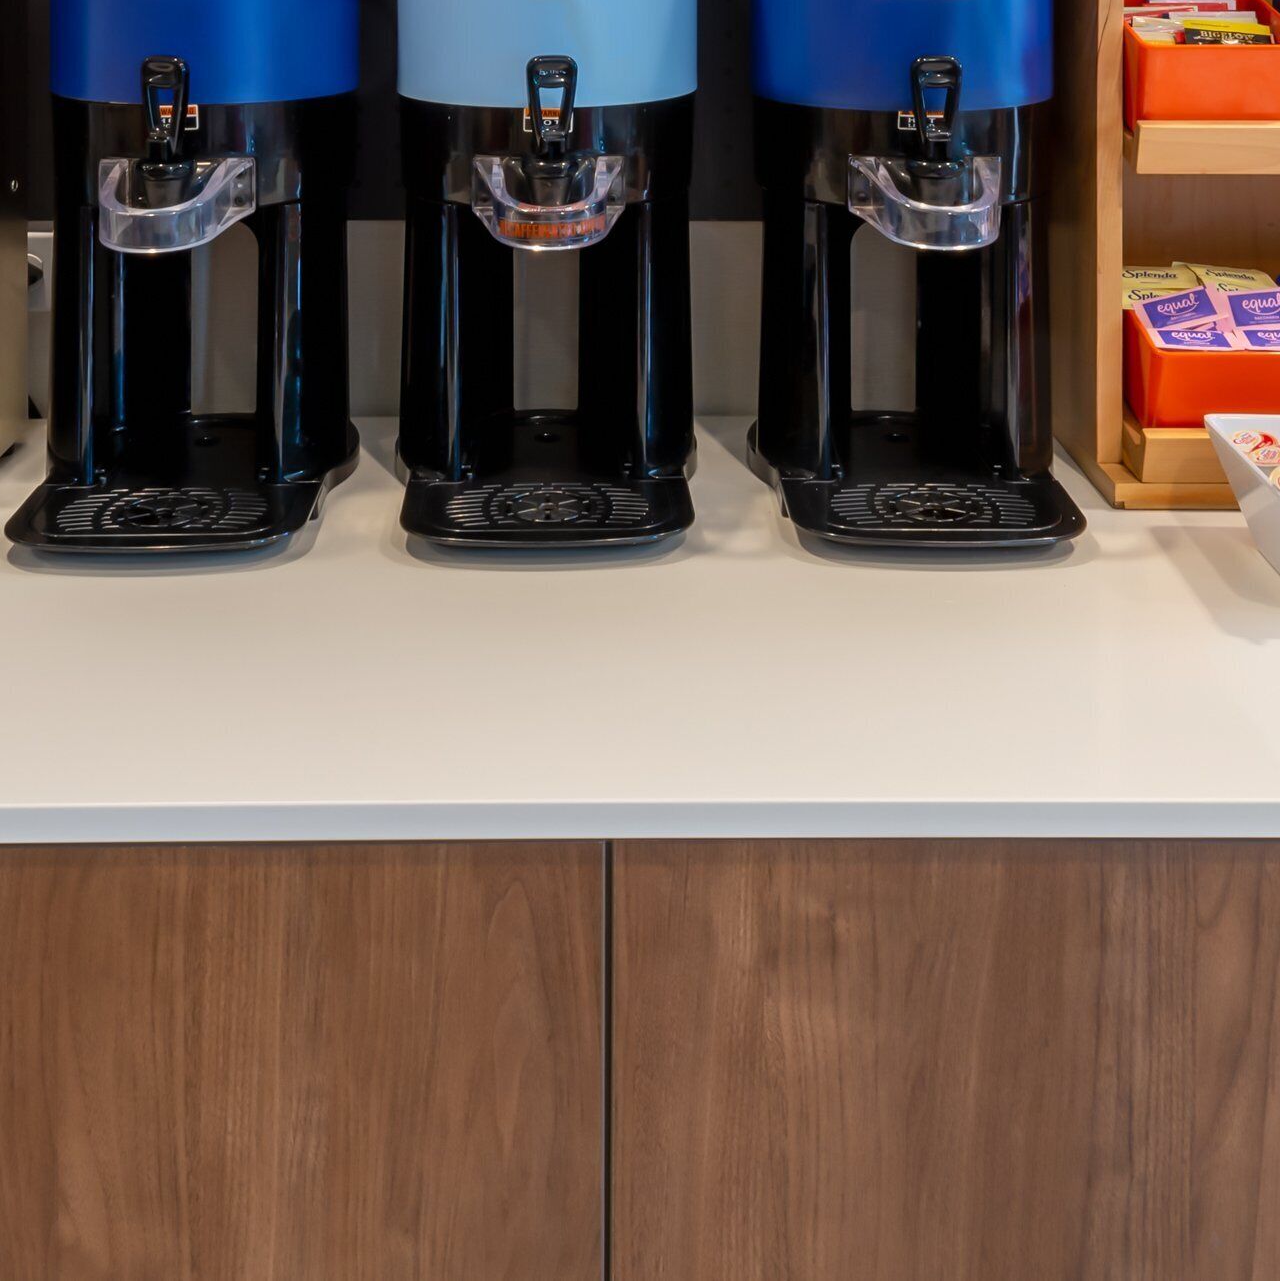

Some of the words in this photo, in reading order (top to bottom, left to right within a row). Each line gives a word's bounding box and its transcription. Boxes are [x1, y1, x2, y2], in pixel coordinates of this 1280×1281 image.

[1122, 269, 1178, 281] Splenda
[1128, 289, 1162, 302] Sple
[1157, 293, 1200, 316] equal
[1171, 330, 1215, 340] equal
